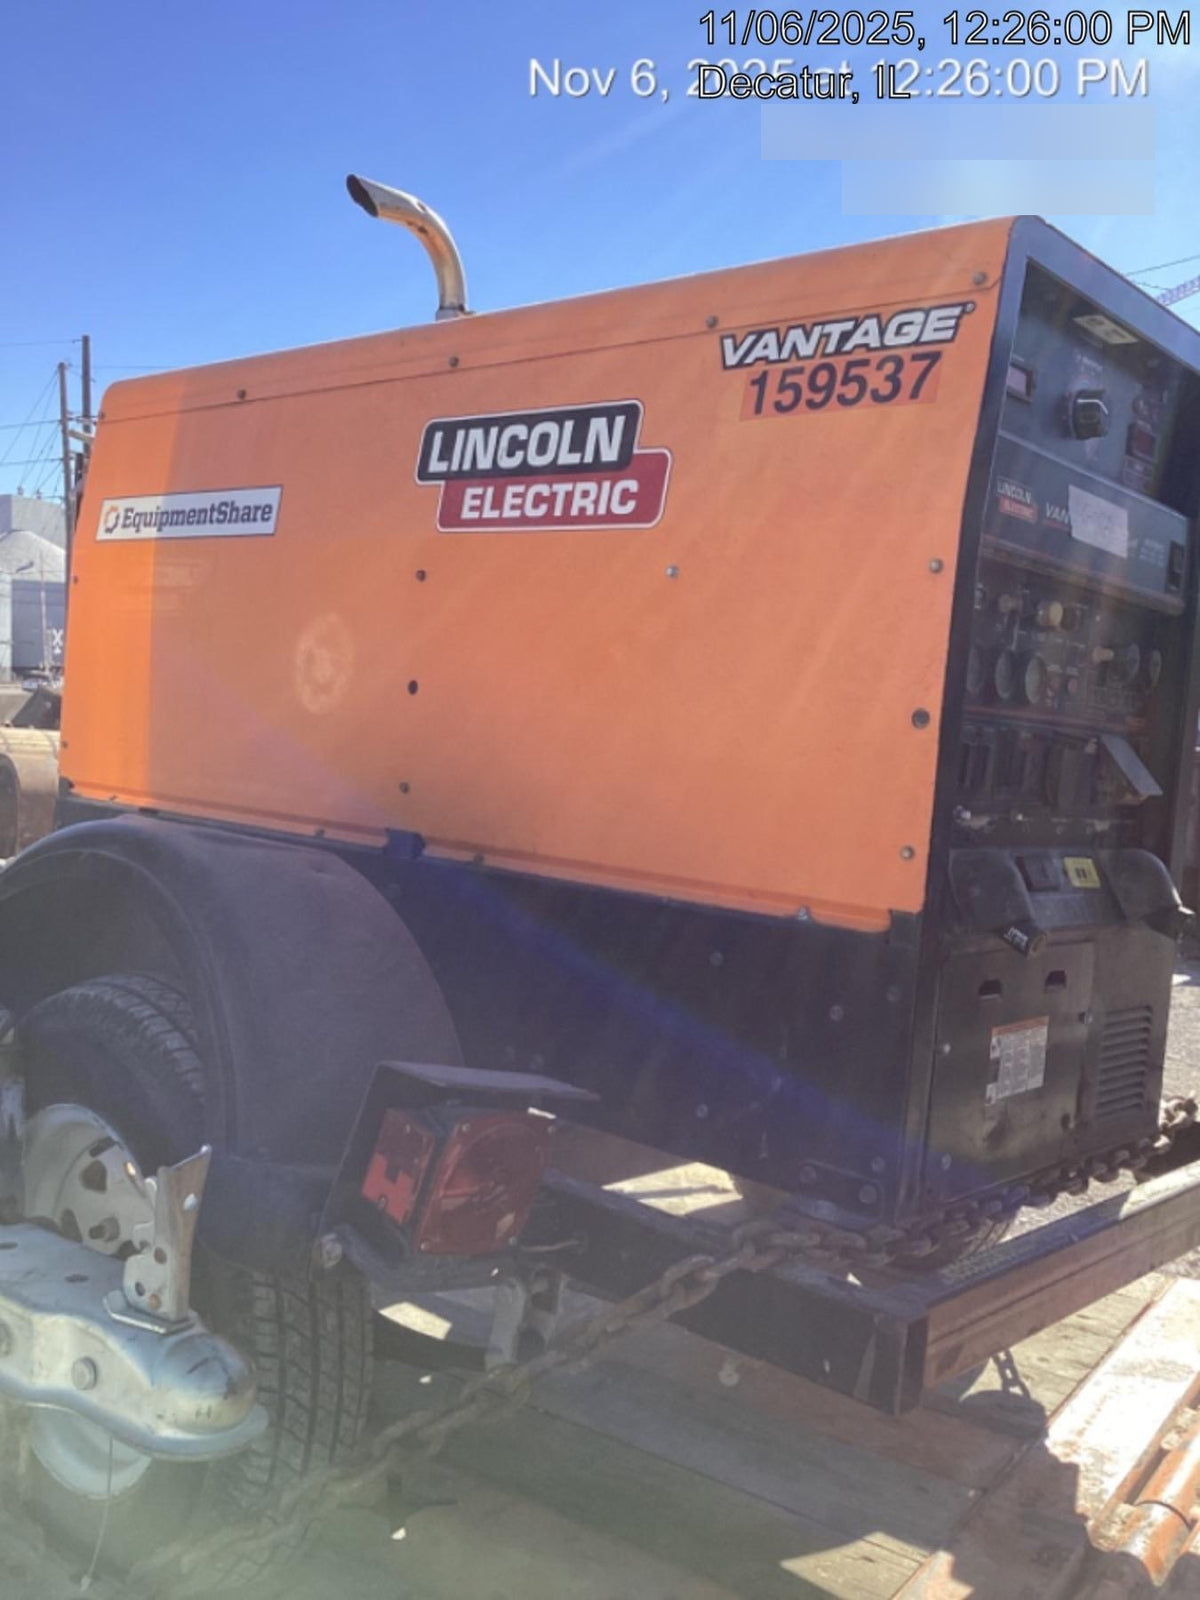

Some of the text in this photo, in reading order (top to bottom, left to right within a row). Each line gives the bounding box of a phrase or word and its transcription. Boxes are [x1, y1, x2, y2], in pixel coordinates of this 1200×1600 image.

[720, 304, 964, 369] VANTAGE
[750, 351, 942, 416] 159537
[428, 414, 626, 473] LINCOLN
[121, 500, 274, 533] EquipmentShare
[460, 479, 639, 520] ELECTRIC
